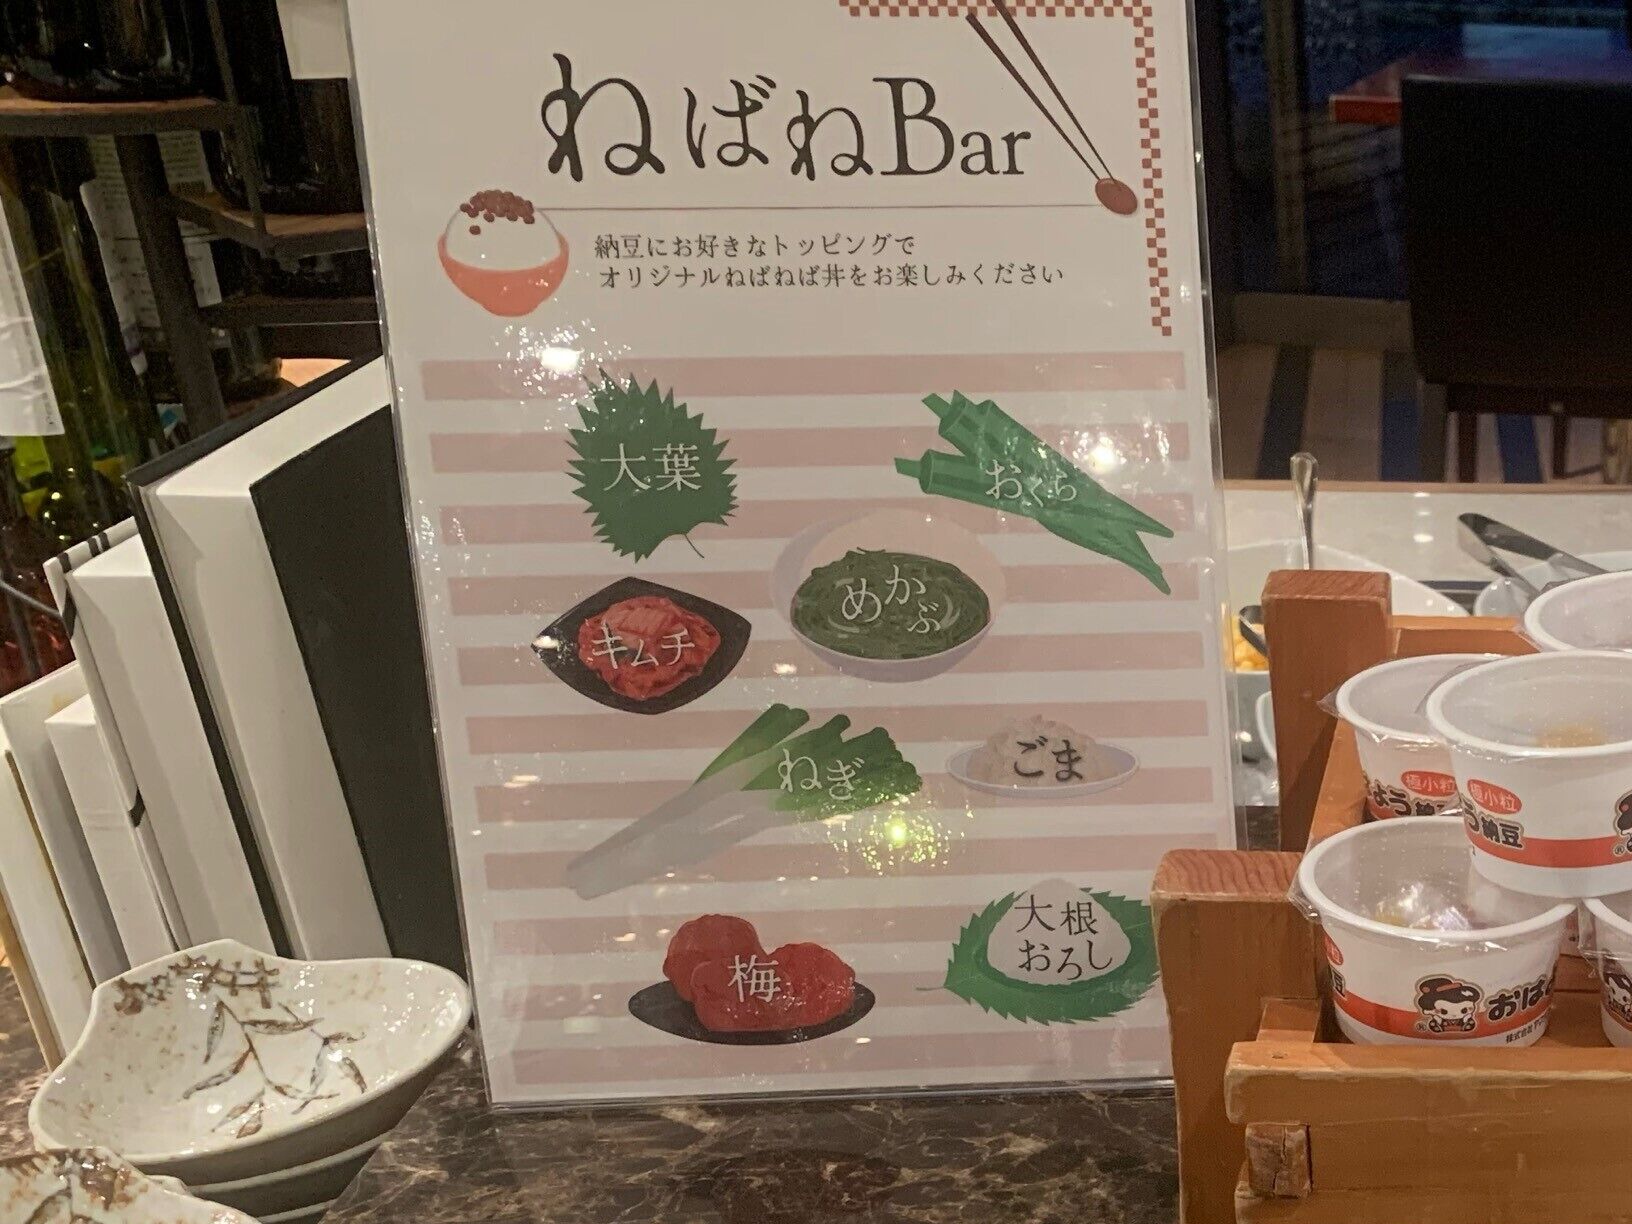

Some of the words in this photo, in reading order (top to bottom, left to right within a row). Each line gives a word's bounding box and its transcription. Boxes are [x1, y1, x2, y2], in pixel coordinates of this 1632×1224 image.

[594, 233, 914, 259] 納豆にお好きなトッピングで
[600, 443, 702, 492] 大葉
[985, 459, 1077, 508] おくら
[840, 563, 942, 636] めかぶ
[592, 624, 696, 671] キムチ
[777, 747, 866, 802] ねぎ
[1012, 736, 1085, 782] ごま
[1013, 894, 1099, 936] 大根
[727, 953, 782, 1004] 梅
[1016, 939, 1114, 981] おろし
